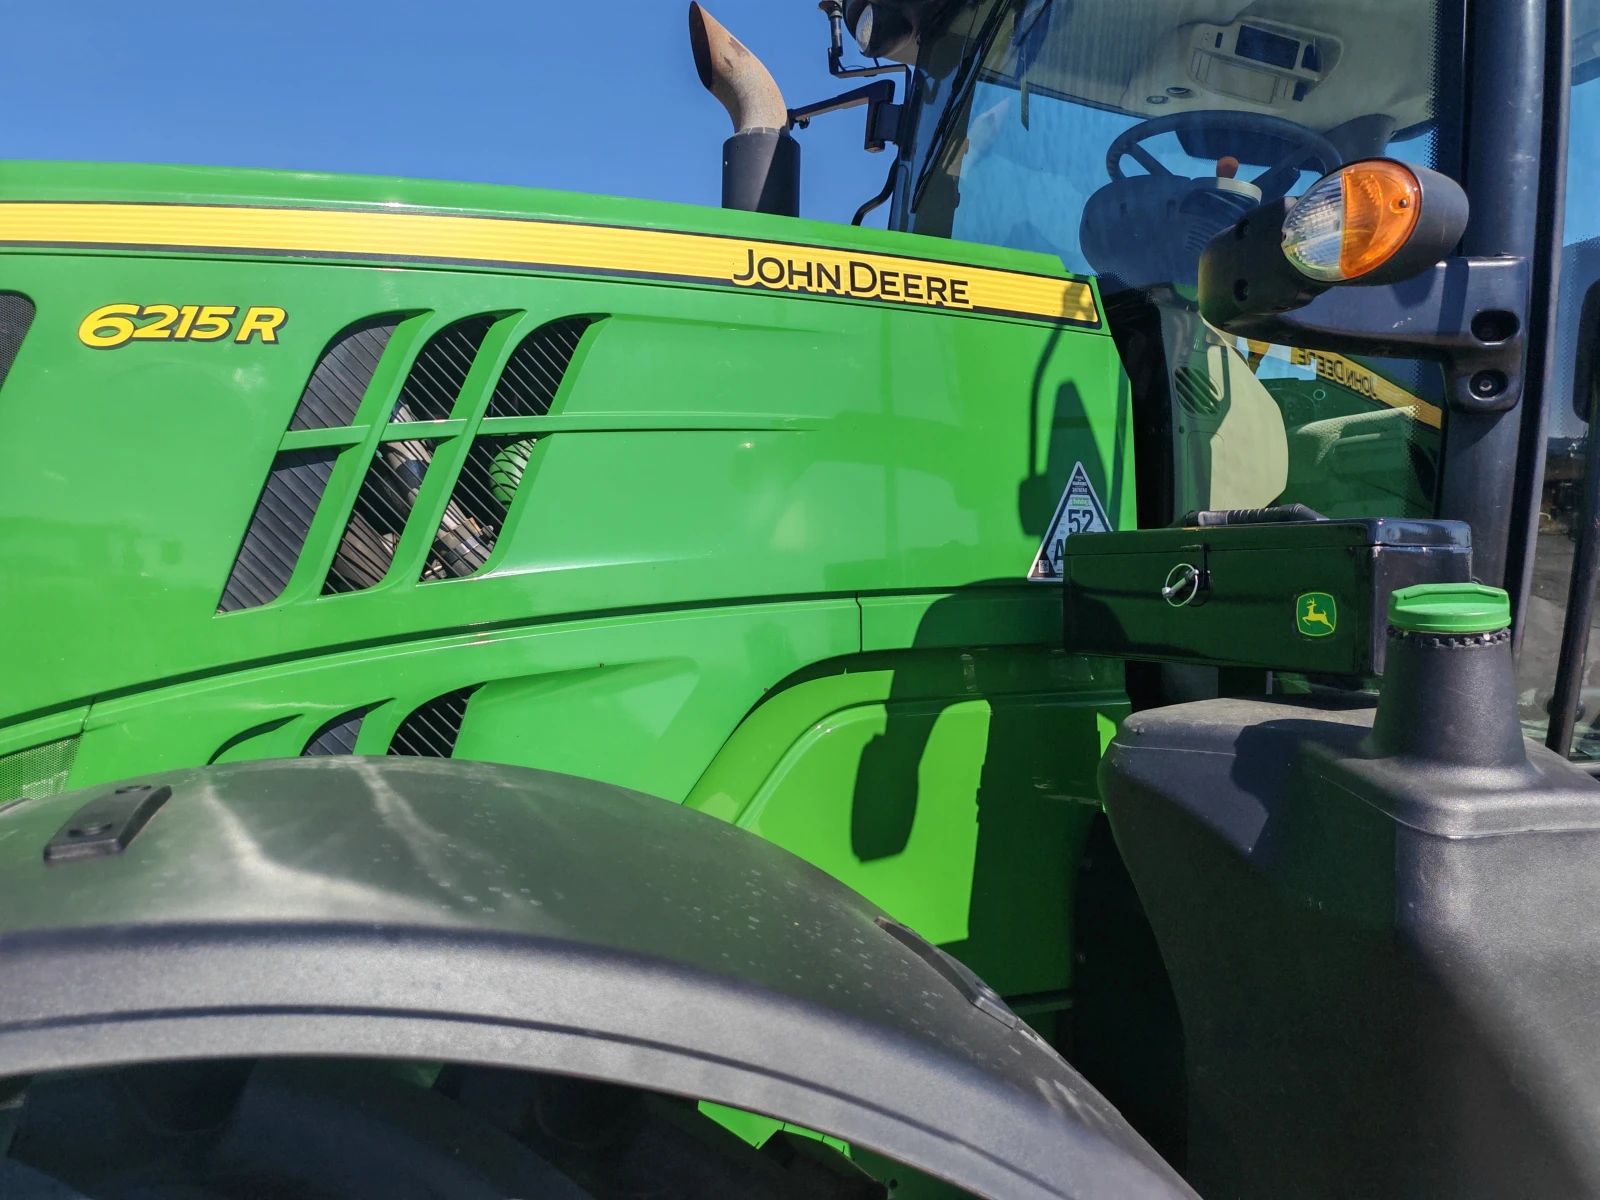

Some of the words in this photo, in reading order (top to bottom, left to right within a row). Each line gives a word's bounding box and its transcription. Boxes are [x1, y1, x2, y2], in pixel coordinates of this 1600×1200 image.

[733, 249, 842, 290] JOHN
[849, 260, 970, 305] DEERE
[1068, 509, 1094, 533] 52
